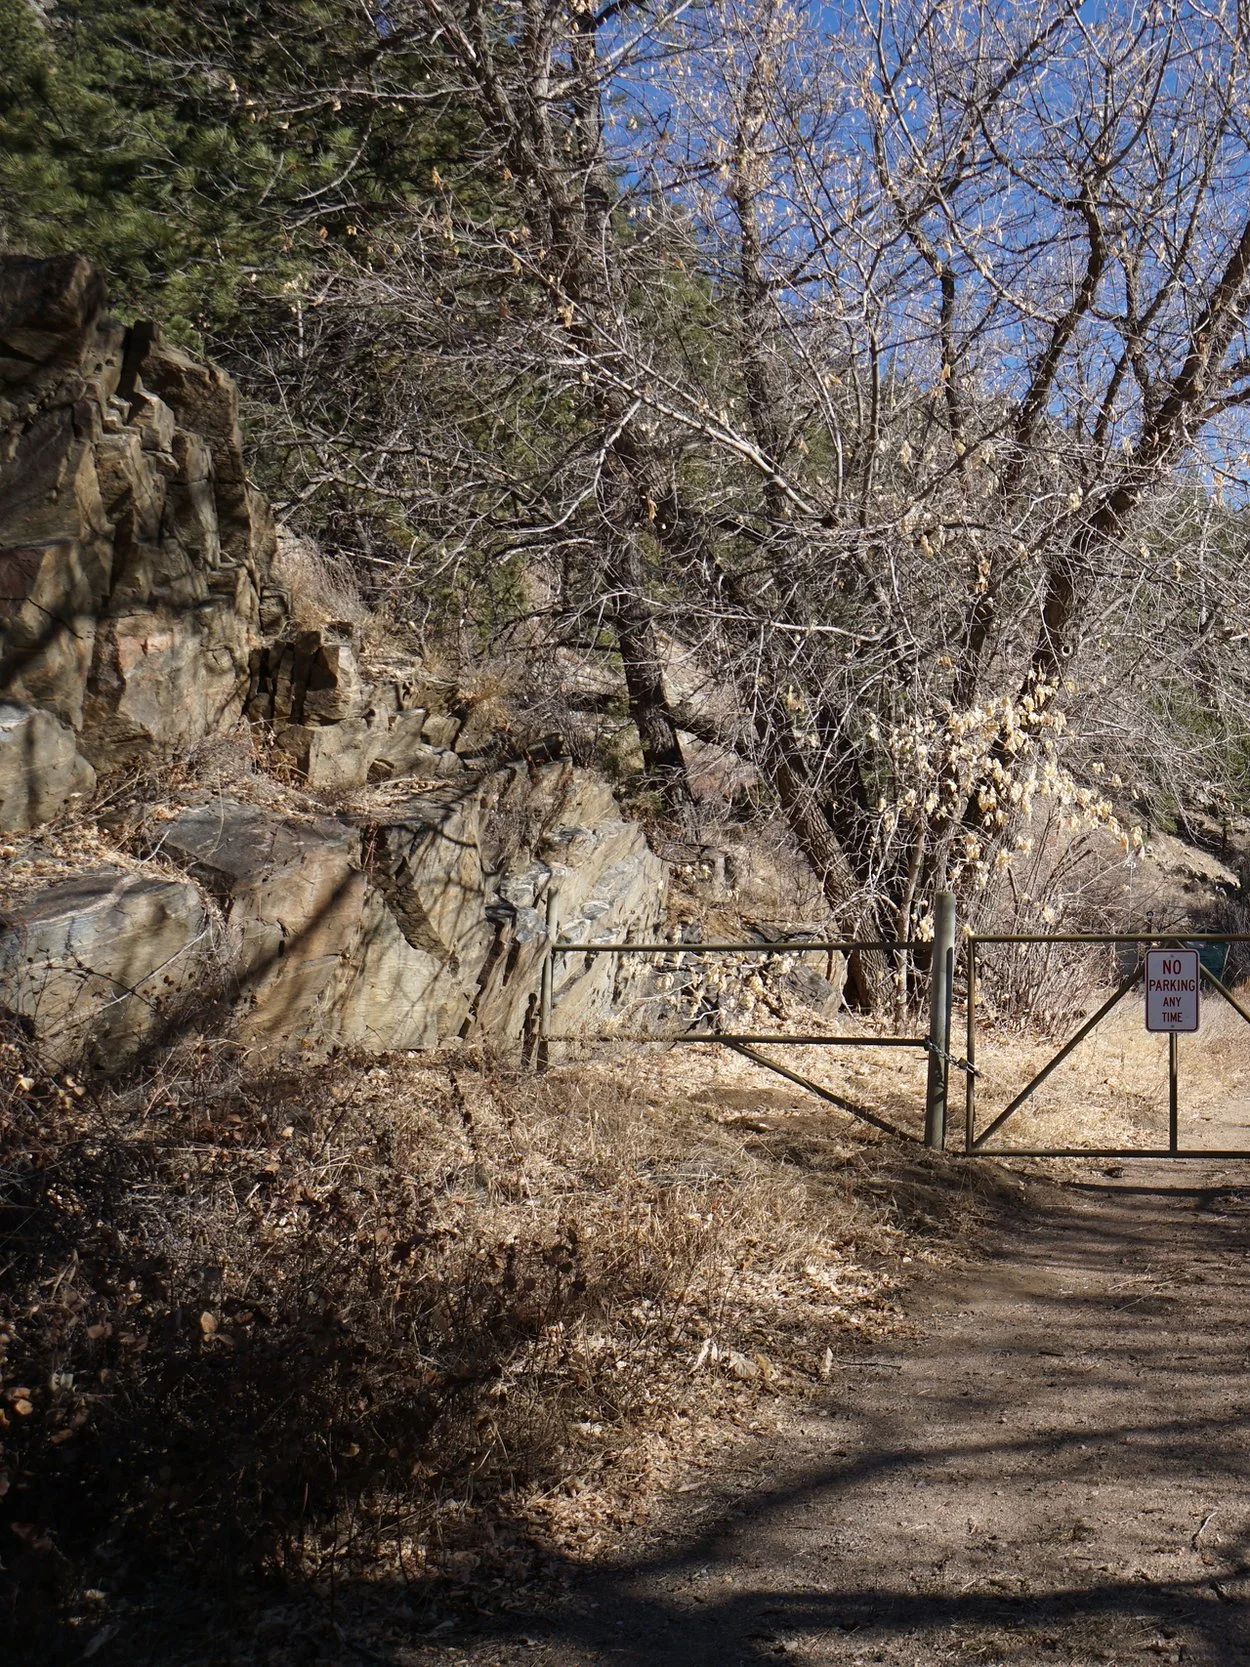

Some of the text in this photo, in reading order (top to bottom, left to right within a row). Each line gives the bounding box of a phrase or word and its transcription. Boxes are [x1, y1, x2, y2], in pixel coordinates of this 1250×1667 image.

[1162, 959, 1182, 975] NO
[1149, 979, 1196, 992] PARKING
[1162, 997, 1182, 1007] ANY
[1162, 1012, 1183, 1023] TIME
